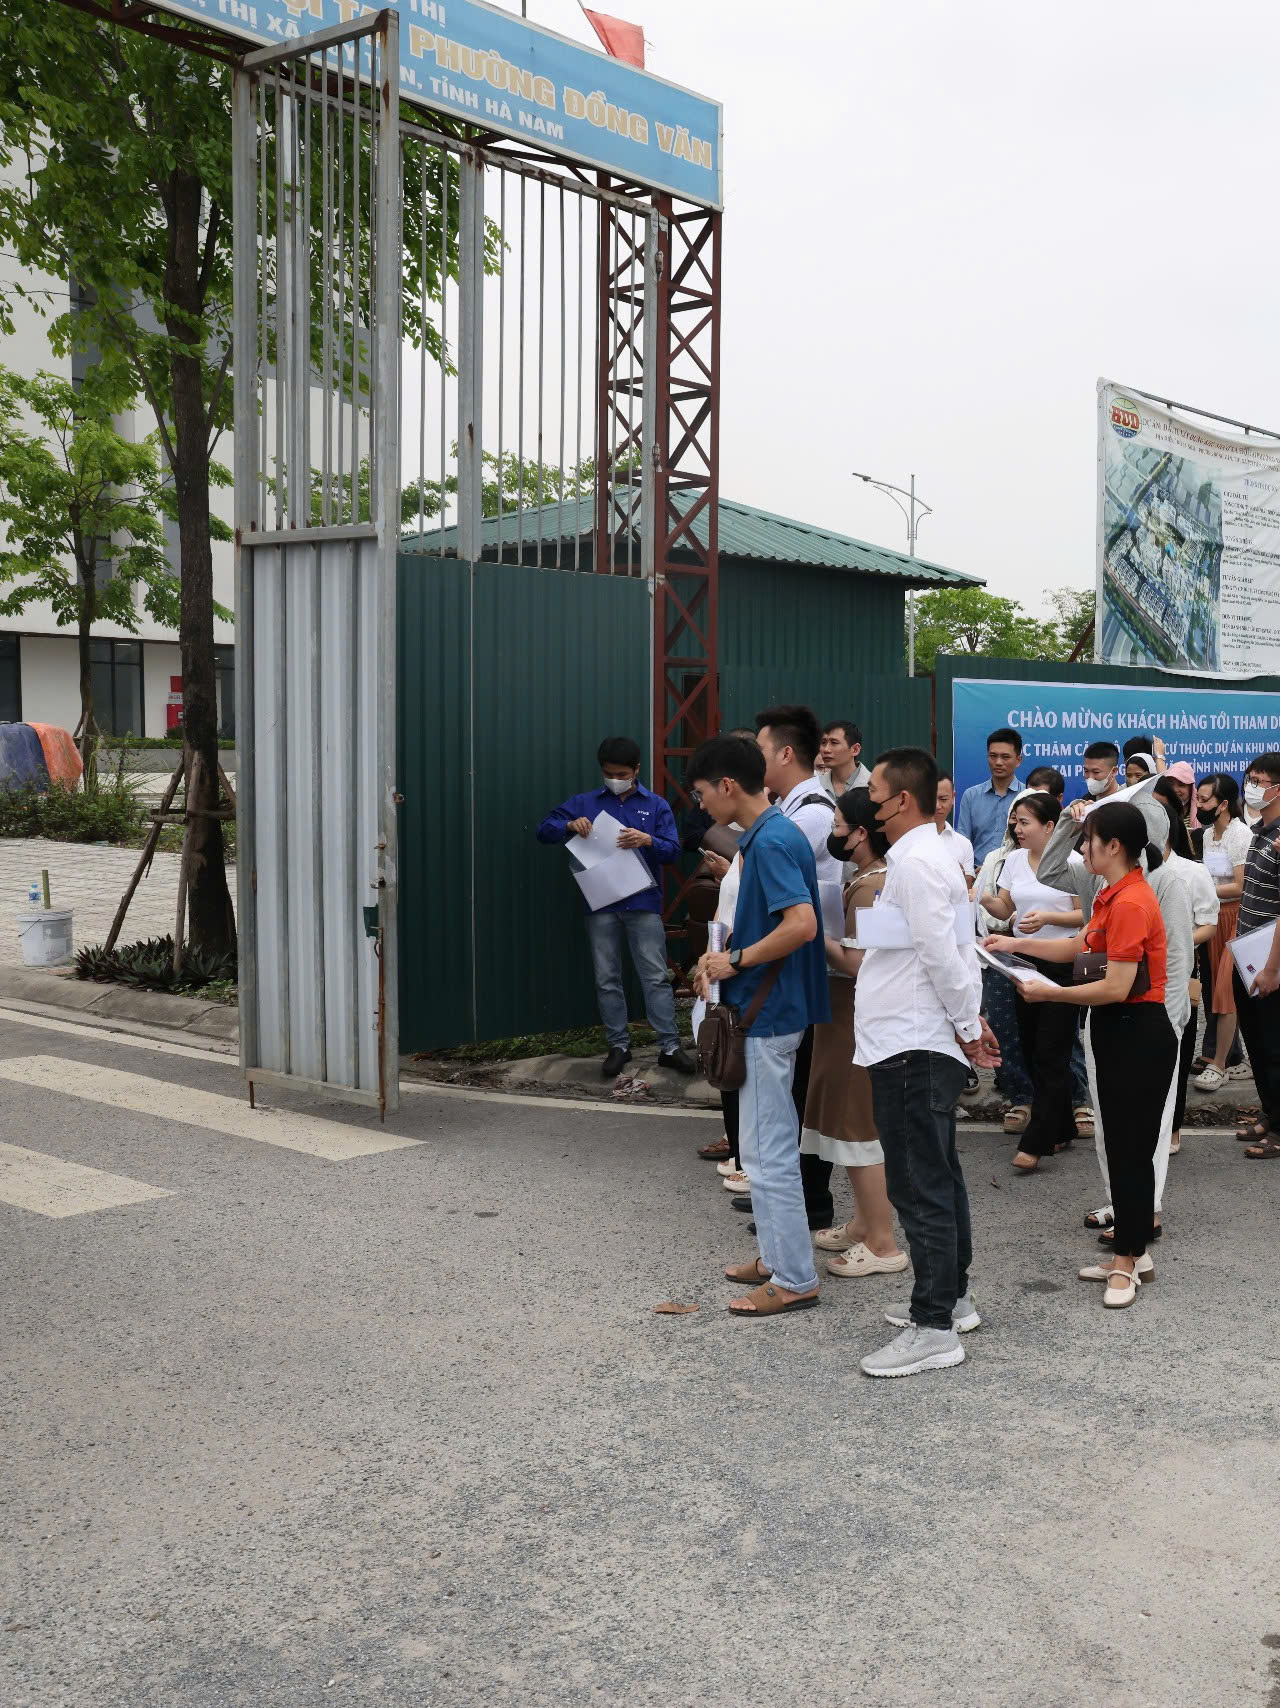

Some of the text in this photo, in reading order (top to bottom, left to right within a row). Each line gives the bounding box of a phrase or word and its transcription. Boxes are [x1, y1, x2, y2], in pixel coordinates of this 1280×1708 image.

[266, 13, 300, 39] XÃ
[429, 75, 478, 109] TỈNH
[485, 96, 512, 122] HÀ
[519, 109, 564, 140] NAM
[408, 23, 713, 170] PHƯỜNG ĐỒNG VĂN
[1007, 706, 1058, 728] CHÀO
[1062, 707, 1113, 729] MỪNG
[1117, 709, 1166, 730] KHÁCH
[1169, 710, 1207, 730] HÀNG
[1210, 711, 1230, 730] TỚI
[1233, 715, 1267, 730] THAM
[1034, 741, 1072, 757] THĂM
[1179, 739, 1213, 757] THUỘC
[1215, 741, 1229, 757] DỰ
[1230, 739, 1244, 754] ÁN
[1246, 742, 1264, 753] KHU
[1214, 760, 1238, 773] NINH
